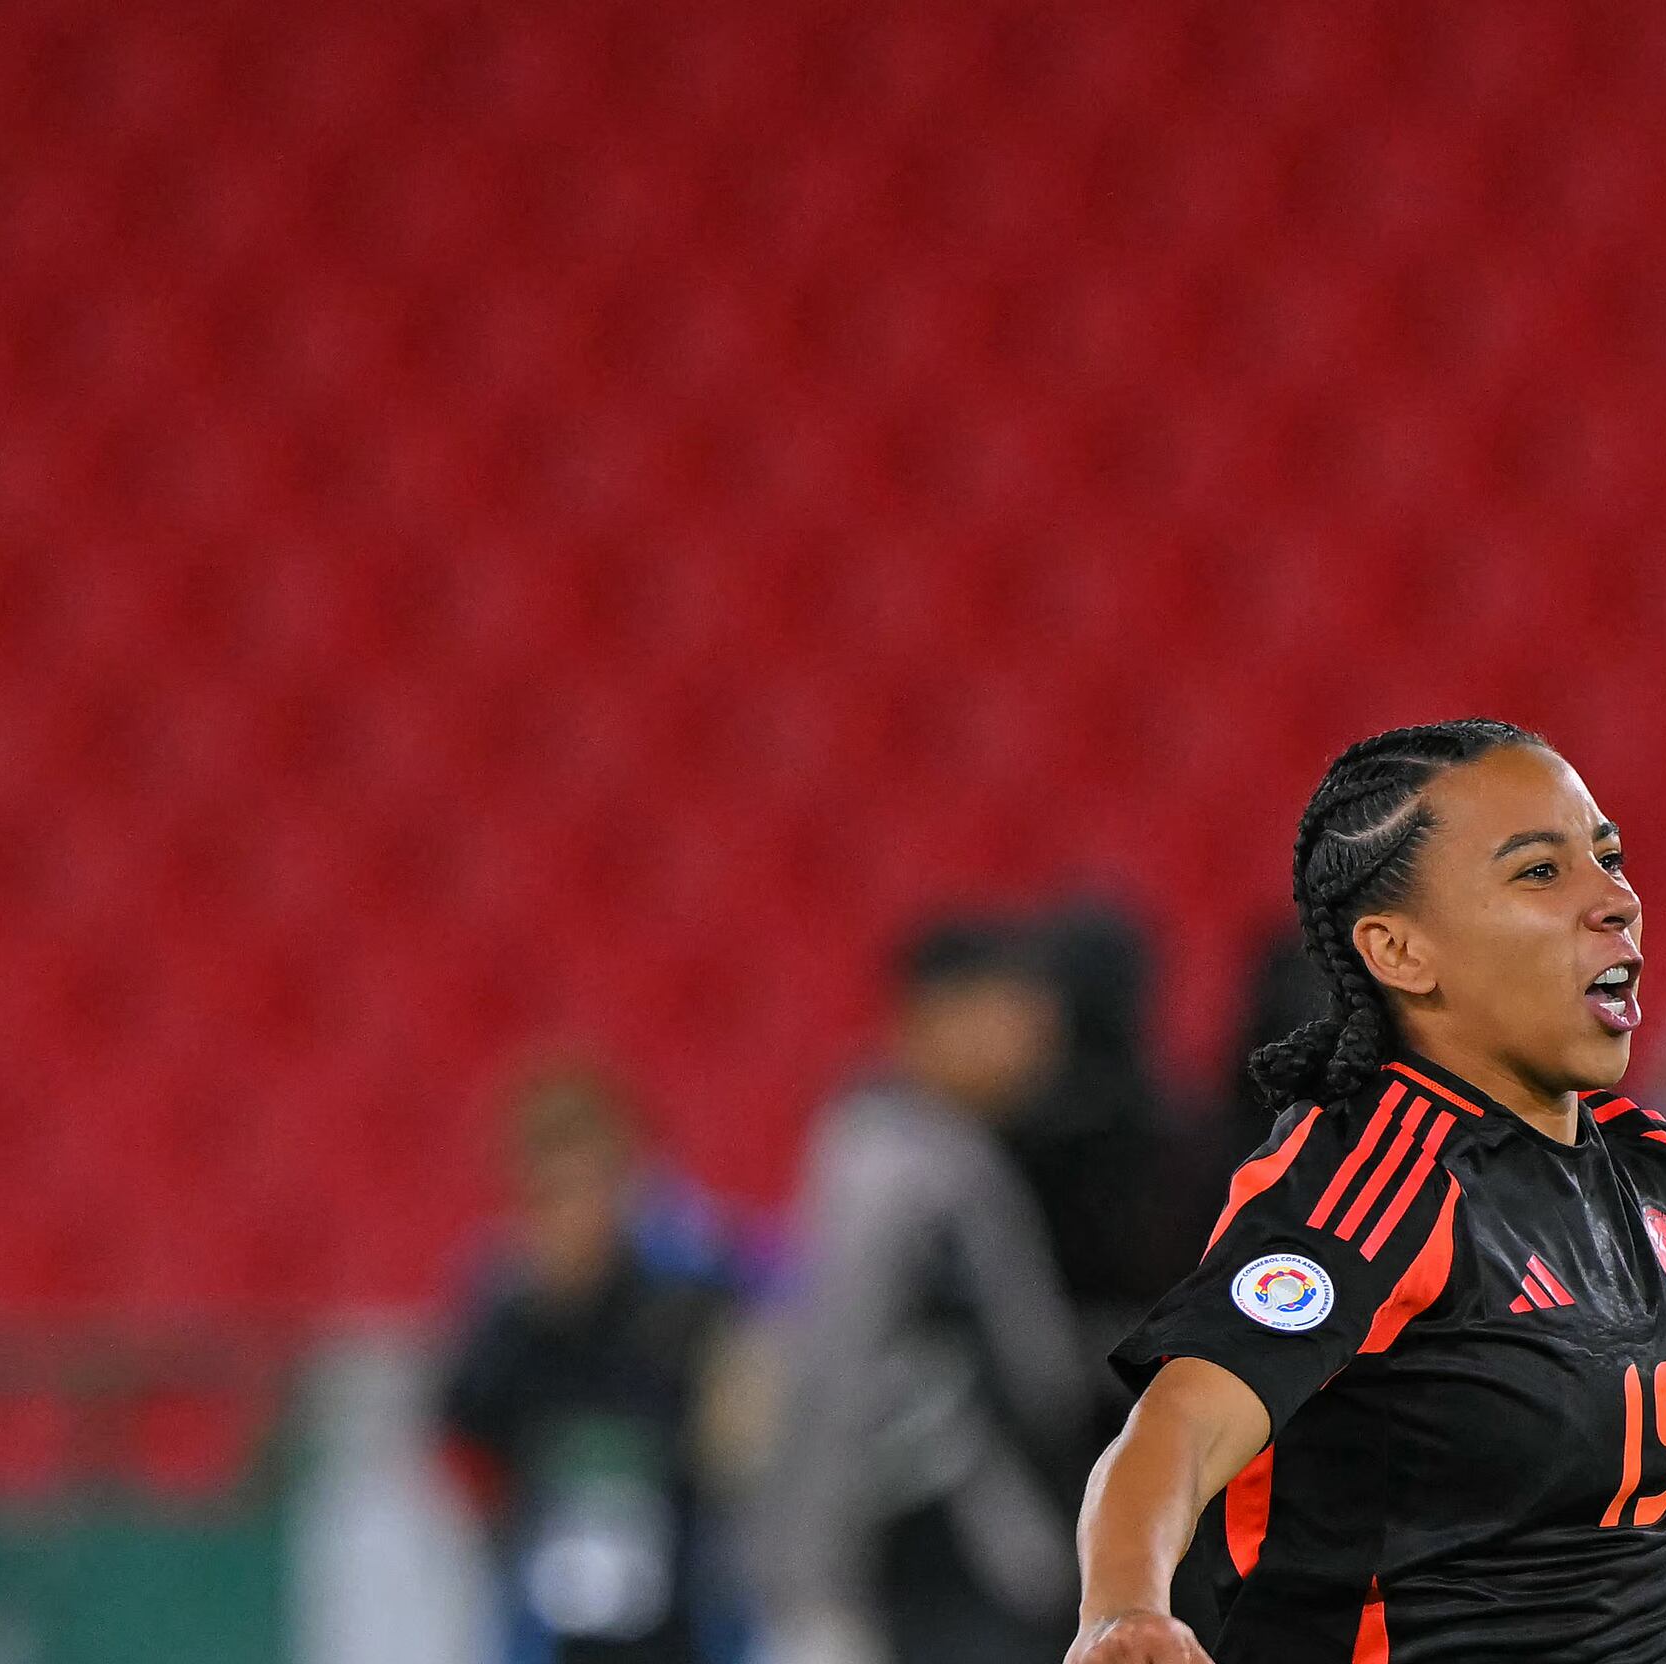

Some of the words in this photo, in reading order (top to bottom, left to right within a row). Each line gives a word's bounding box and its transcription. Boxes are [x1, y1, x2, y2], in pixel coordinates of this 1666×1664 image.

[1242, 1257, 1280, 1278] CONMEBOL
[1280, 1256, 1301, 1264] COPA
[1238, 1298, 1269, 1322] ECUADOR
